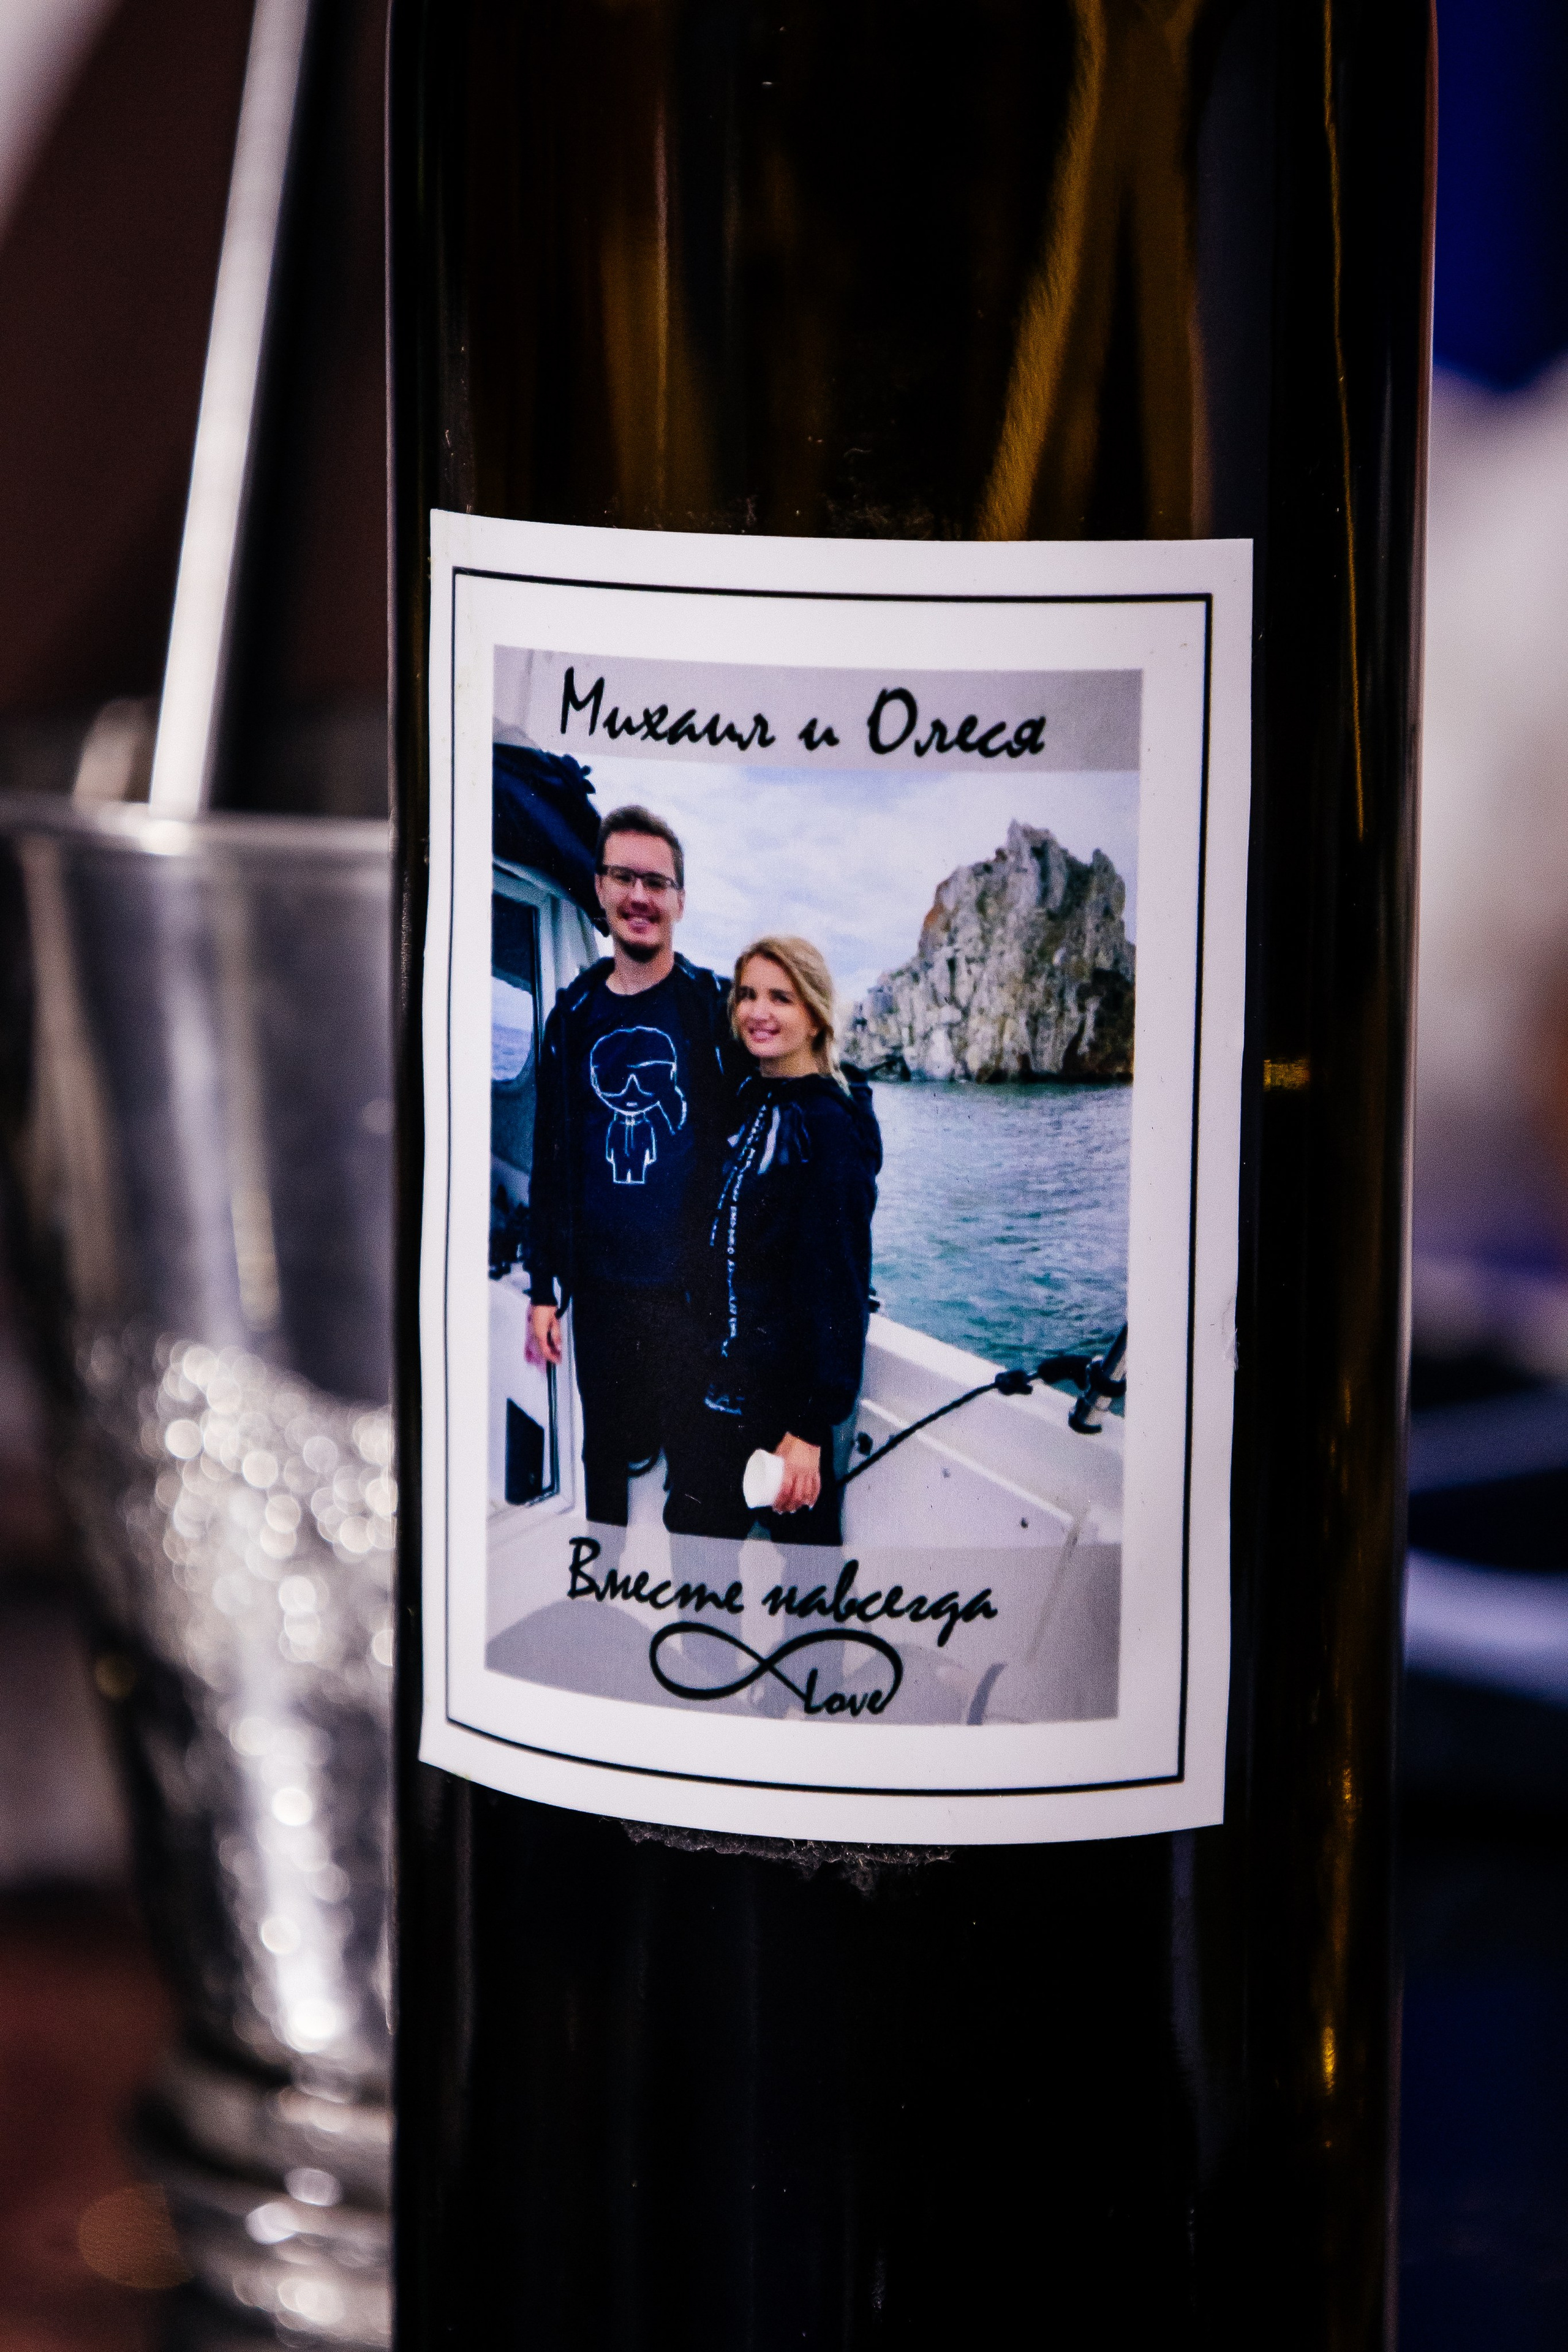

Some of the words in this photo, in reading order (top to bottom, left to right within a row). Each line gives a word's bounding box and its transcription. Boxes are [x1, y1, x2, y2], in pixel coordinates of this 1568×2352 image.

[560, 666, 775, 750] Михаил
[798, 718, 840, 750] и
[867, 687, 1046, 758] Олеся
[567, 1536, 744, 1613] Вместе
[763, 1559, 997, 1646] навсегда
